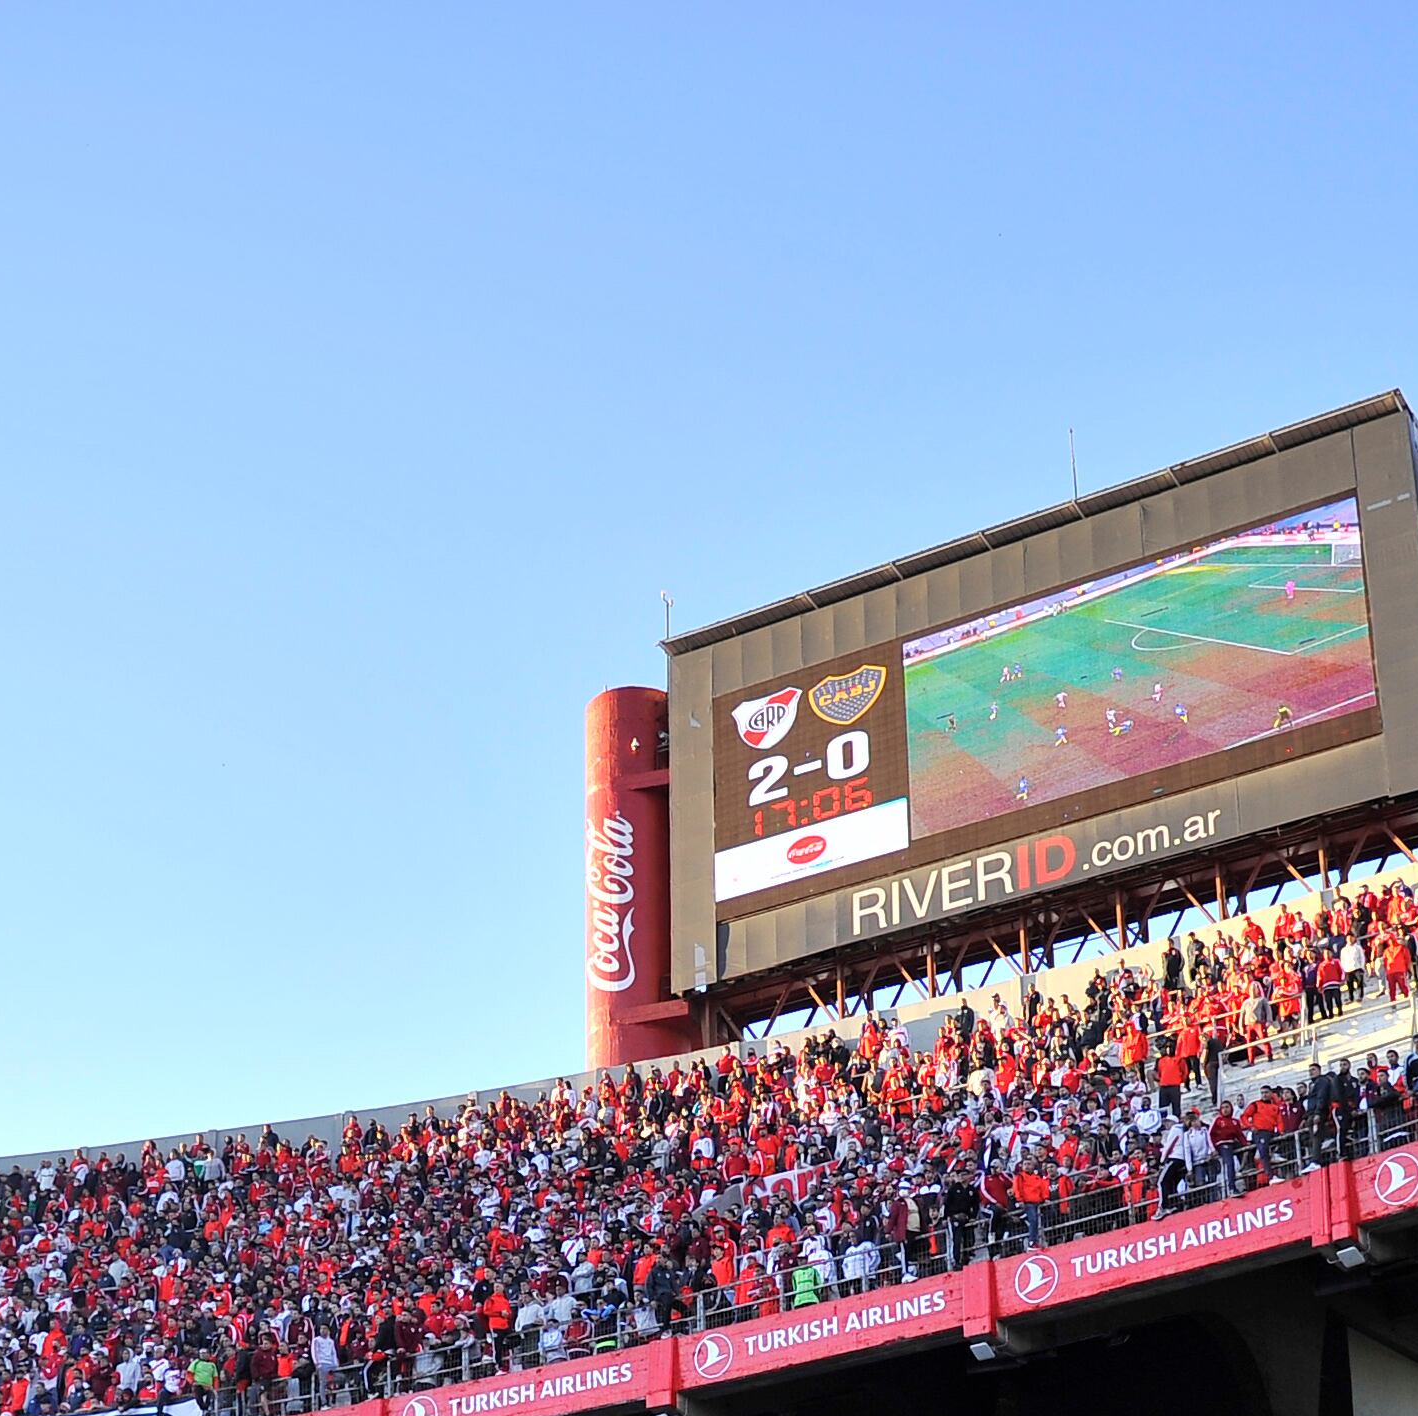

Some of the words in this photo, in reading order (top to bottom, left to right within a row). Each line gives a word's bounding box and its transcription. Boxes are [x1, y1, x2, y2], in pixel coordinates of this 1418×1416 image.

[748, 730, 870, 807] 2-0
[1070, 1231, 1178, 1276] TURKISH
[1180, 1199, 1294, 1250] AIRLINES
[743, 1314, 840, 1356] TURKISH
[845, 1289, 947, 1331] AIRLINES
[447, 1381, 535, 1416] TURKISH
[540, 1361, 633, 1398] AIRLINES
